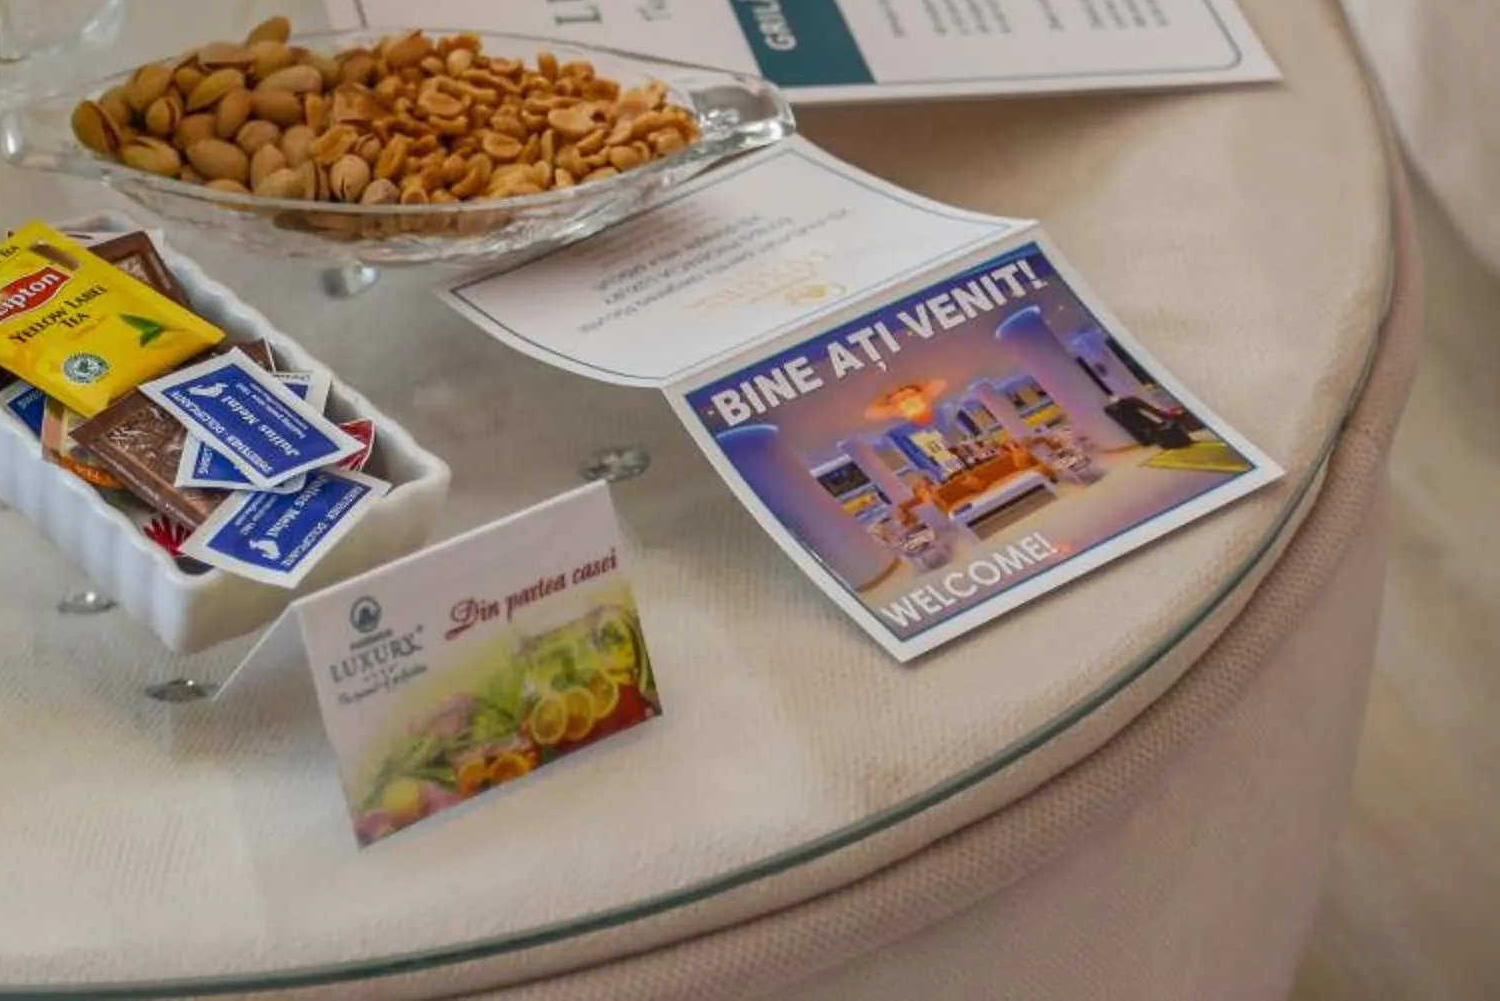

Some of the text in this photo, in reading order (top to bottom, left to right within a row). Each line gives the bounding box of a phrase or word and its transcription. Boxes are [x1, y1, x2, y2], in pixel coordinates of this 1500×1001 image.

[8, 307, 68, 344] YELLOW
[61, 312, 91, 328] TEA
[711, 355, 824, 429] BINE
[826, 321, 901, 373] AȚI
[898, 258, 1048, 340] VENIT!
[445, 547, 618, 641] Din partea casei
[881, 532, 1058, 630] WELCOME!
